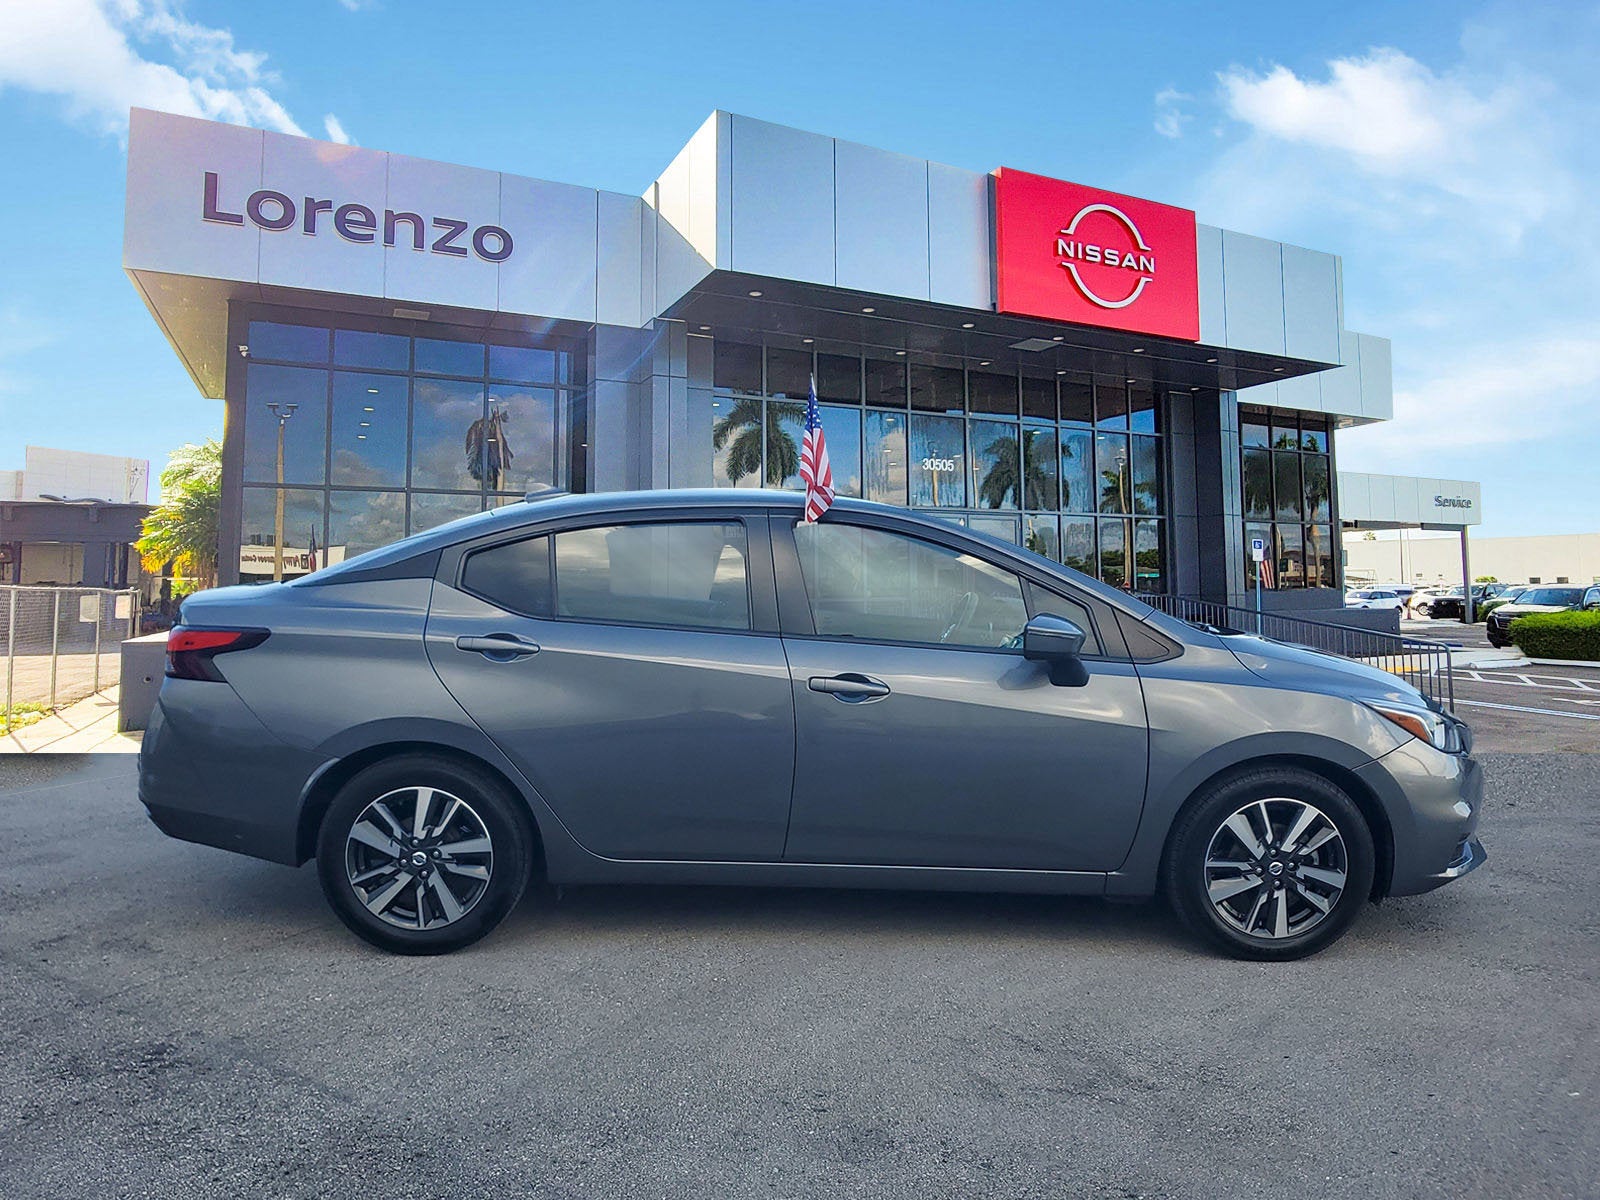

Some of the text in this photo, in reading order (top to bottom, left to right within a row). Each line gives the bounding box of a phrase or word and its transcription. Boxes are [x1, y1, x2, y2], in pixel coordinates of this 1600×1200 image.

[202, 171, 514, 262] Lorenzo
[1057, 238, 1155, 273] NISSAN
[922, 458, 955, 471] 30505
[1434, 495, 1472, 508] Service
